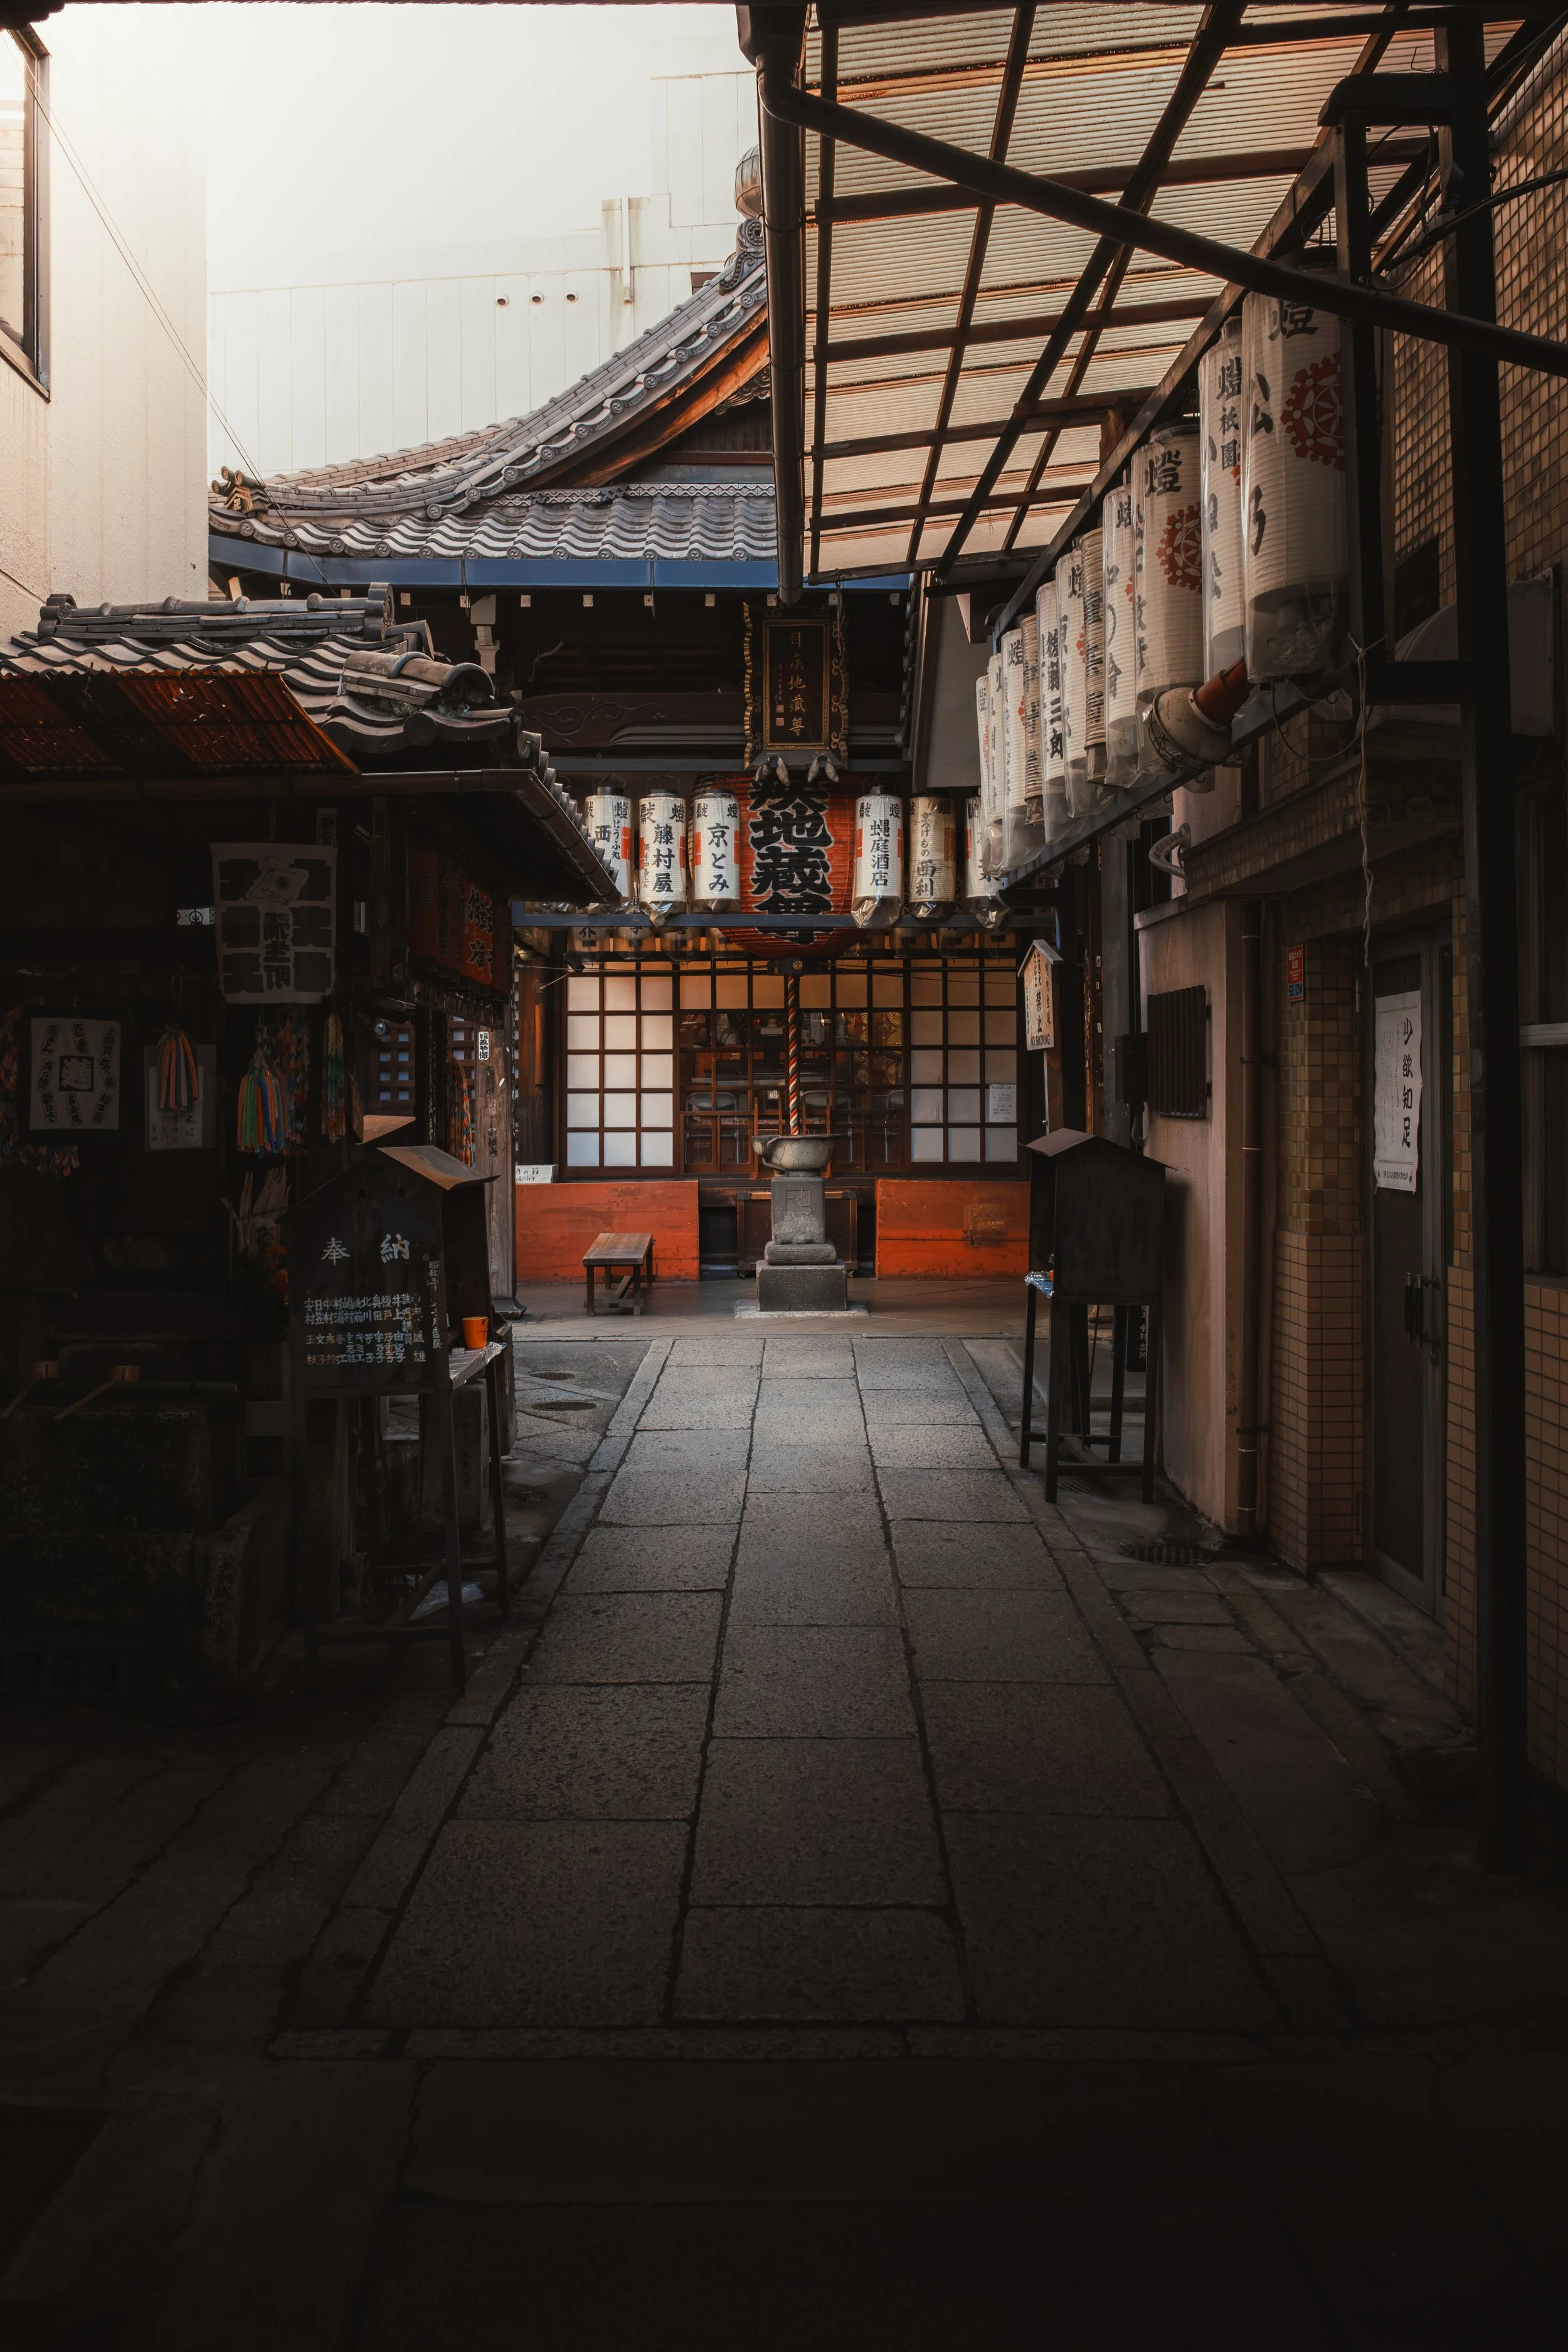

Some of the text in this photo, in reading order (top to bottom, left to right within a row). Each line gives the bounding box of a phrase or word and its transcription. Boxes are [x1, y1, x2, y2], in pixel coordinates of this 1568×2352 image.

[1145, 450, 1183, 498] 燈
[652, 824, 675, 893] 藤村屋
[707, 822, 729, 893] 京とみ
[1036, 1034, 1051, 1046] SMOKING
[1402, 1017, 1413, 1148] 少欲知足
